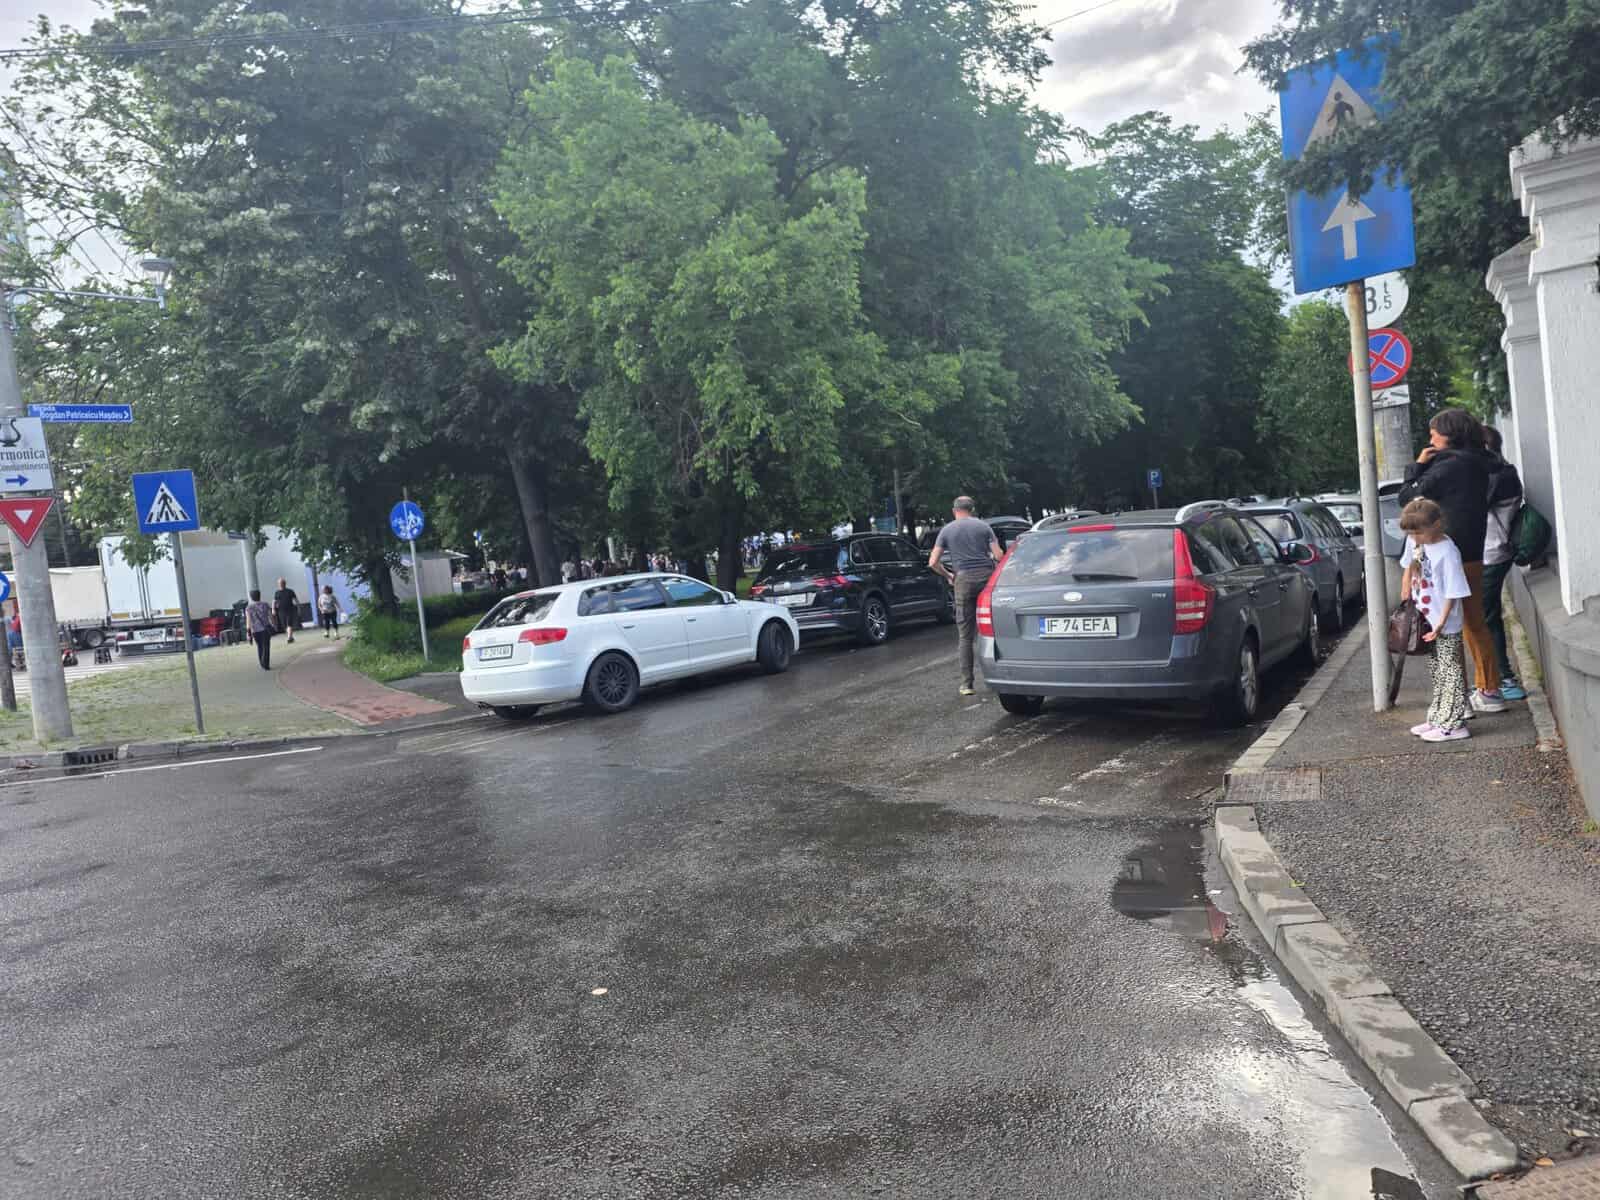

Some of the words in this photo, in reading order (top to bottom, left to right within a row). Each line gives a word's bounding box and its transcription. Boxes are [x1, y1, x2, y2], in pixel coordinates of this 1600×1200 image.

[1047, 619, 1059, 633] IF
[1064, 618, 1079, 632] 74
[1082, 617, 1111, 632] EFA
